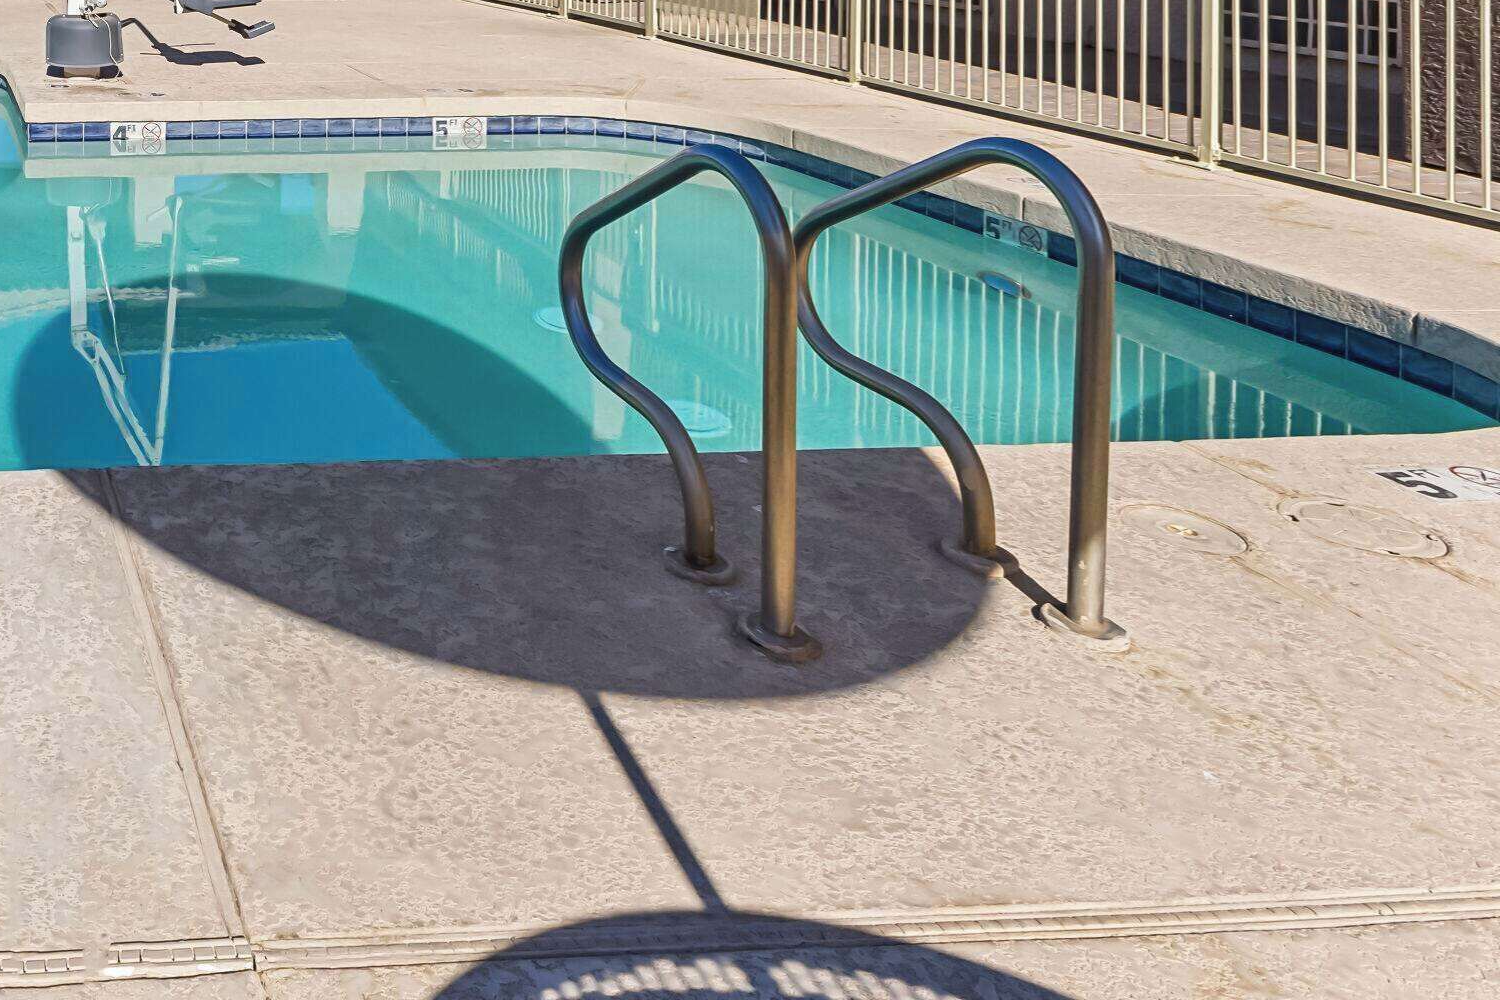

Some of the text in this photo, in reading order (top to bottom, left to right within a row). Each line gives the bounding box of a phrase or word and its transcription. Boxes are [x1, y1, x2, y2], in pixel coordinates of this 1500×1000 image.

[113, 124, 137, 140] 4 FT
[436, 120, 448, 135] 5
[986, 216, 1000, 240] 5
[1375, 469, 1458, 499] 5 FT
